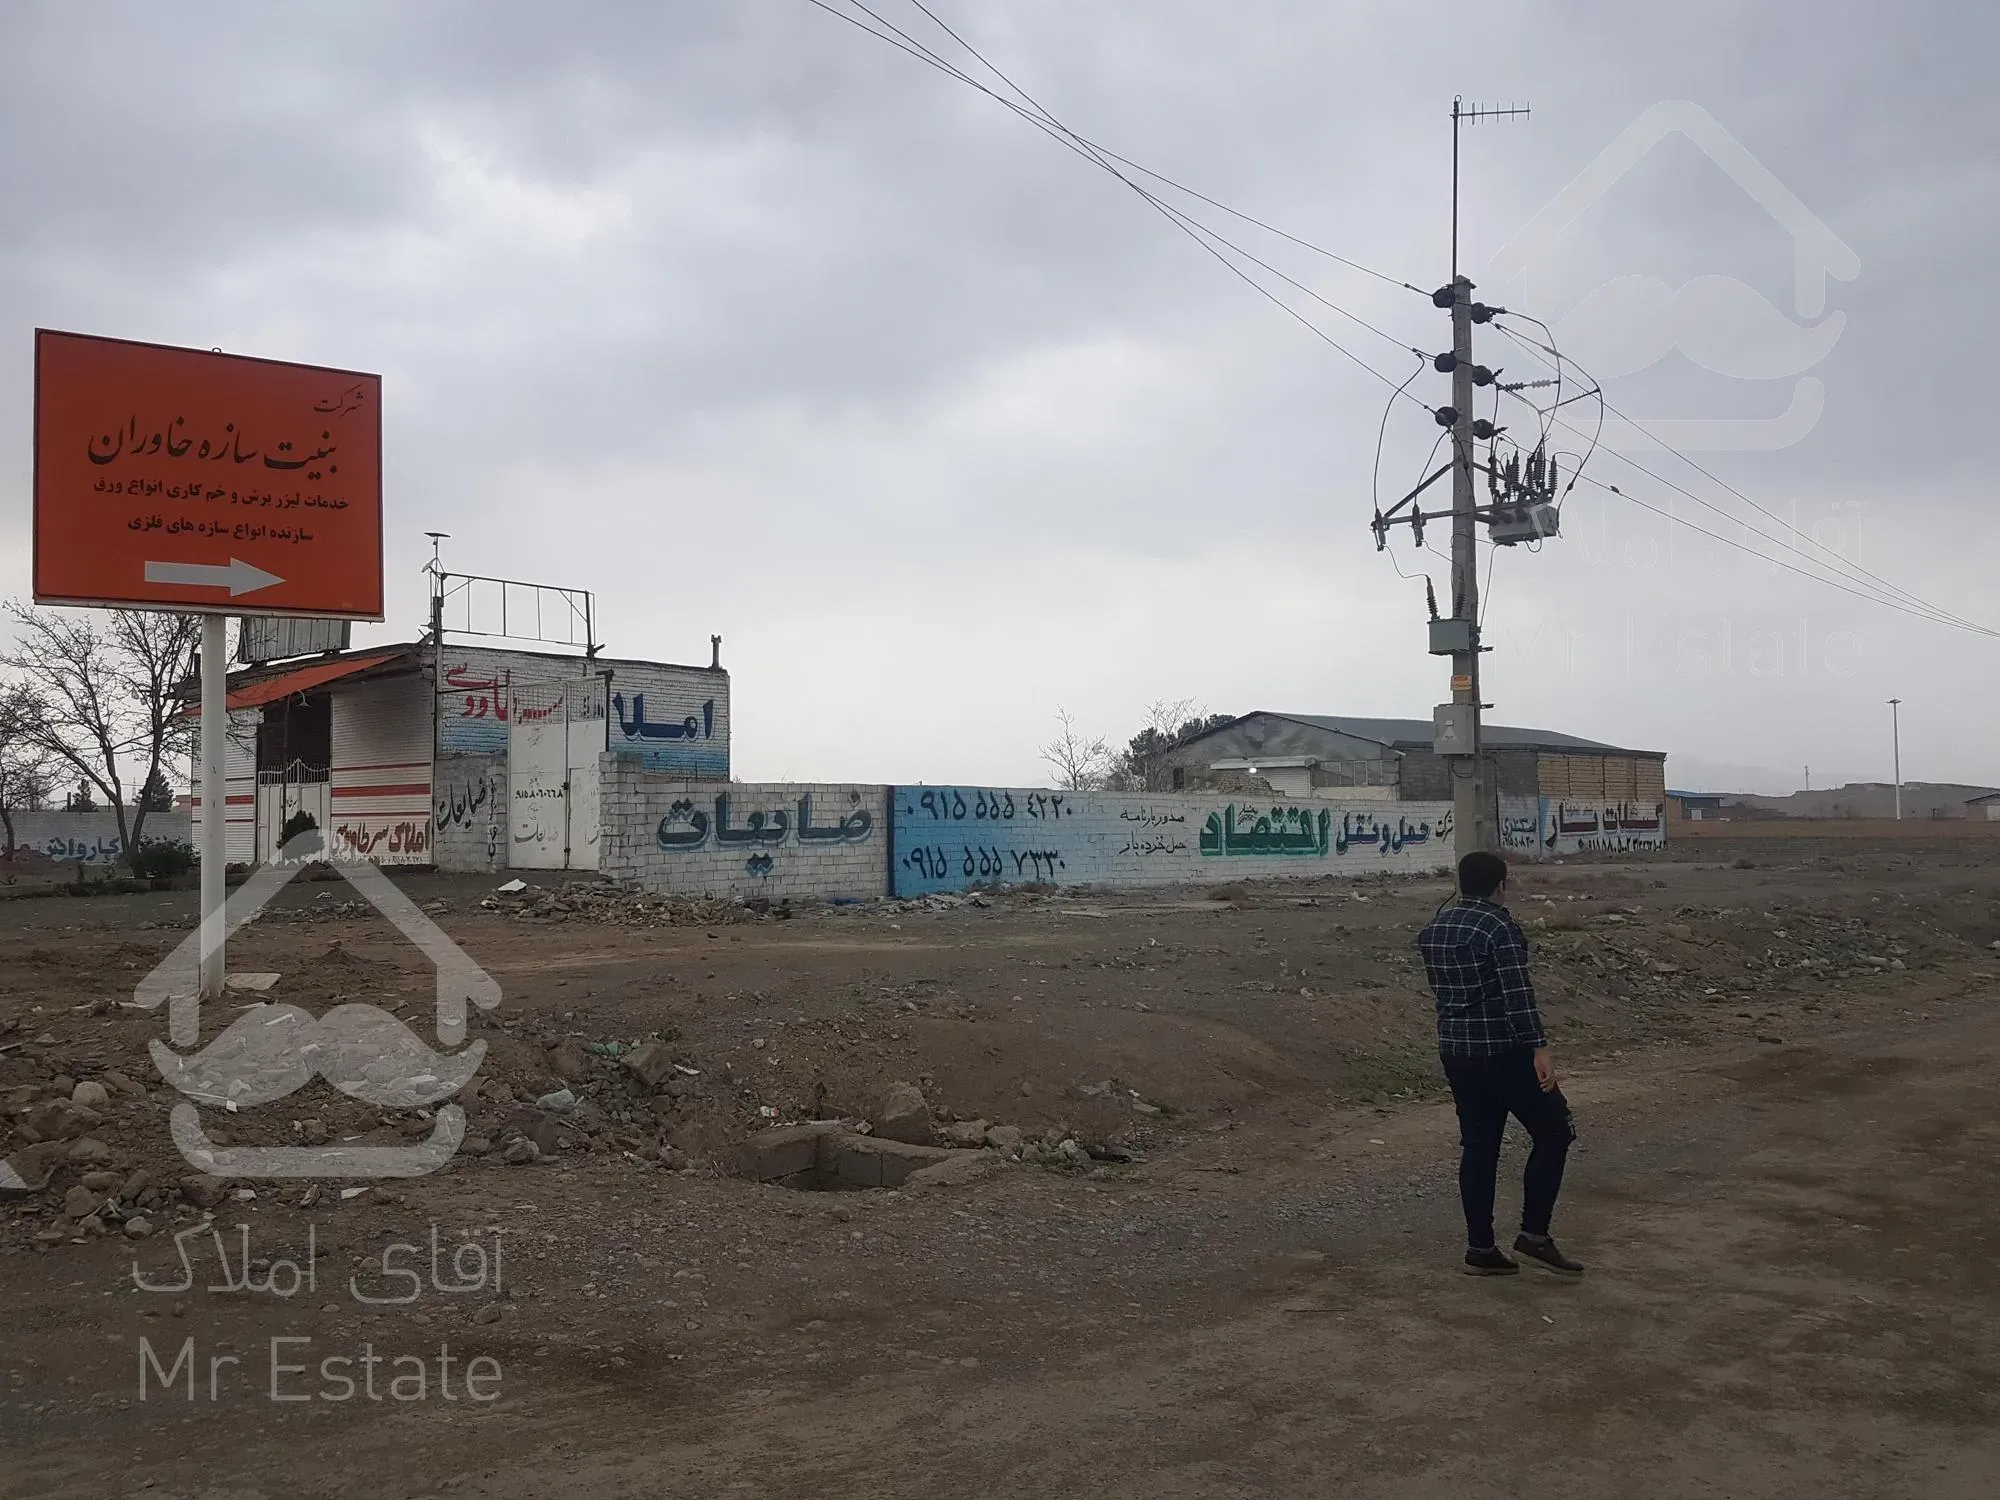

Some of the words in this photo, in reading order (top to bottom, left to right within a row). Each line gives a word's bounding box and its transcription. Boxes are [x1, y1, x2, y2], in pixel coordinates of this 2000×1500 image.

[312, 383, 365, 417] شرکت
[87, 414, 193, 466] خاوران
[197, 423, 257, 465] سازه
[93, 476, 124, 494] ورق
[127, 477, 163, 496] انواع
[166, 482, 203, 500] کاری
[205, 482, 227, 502] خم
[230, 489, 239, 504] و
[275, 490, 301, 508] لیزر
[304, 493, 350, 510] خدمات
[127, 514, 164, 531] فلزی
[166, 516, 195, 534] های
[197, 518, 230, 535] سازه
[233, 522, 267, 542] انواع
[269, 527, 315, 544] سازنده
[657, 790, 873, 877] ضایعات
